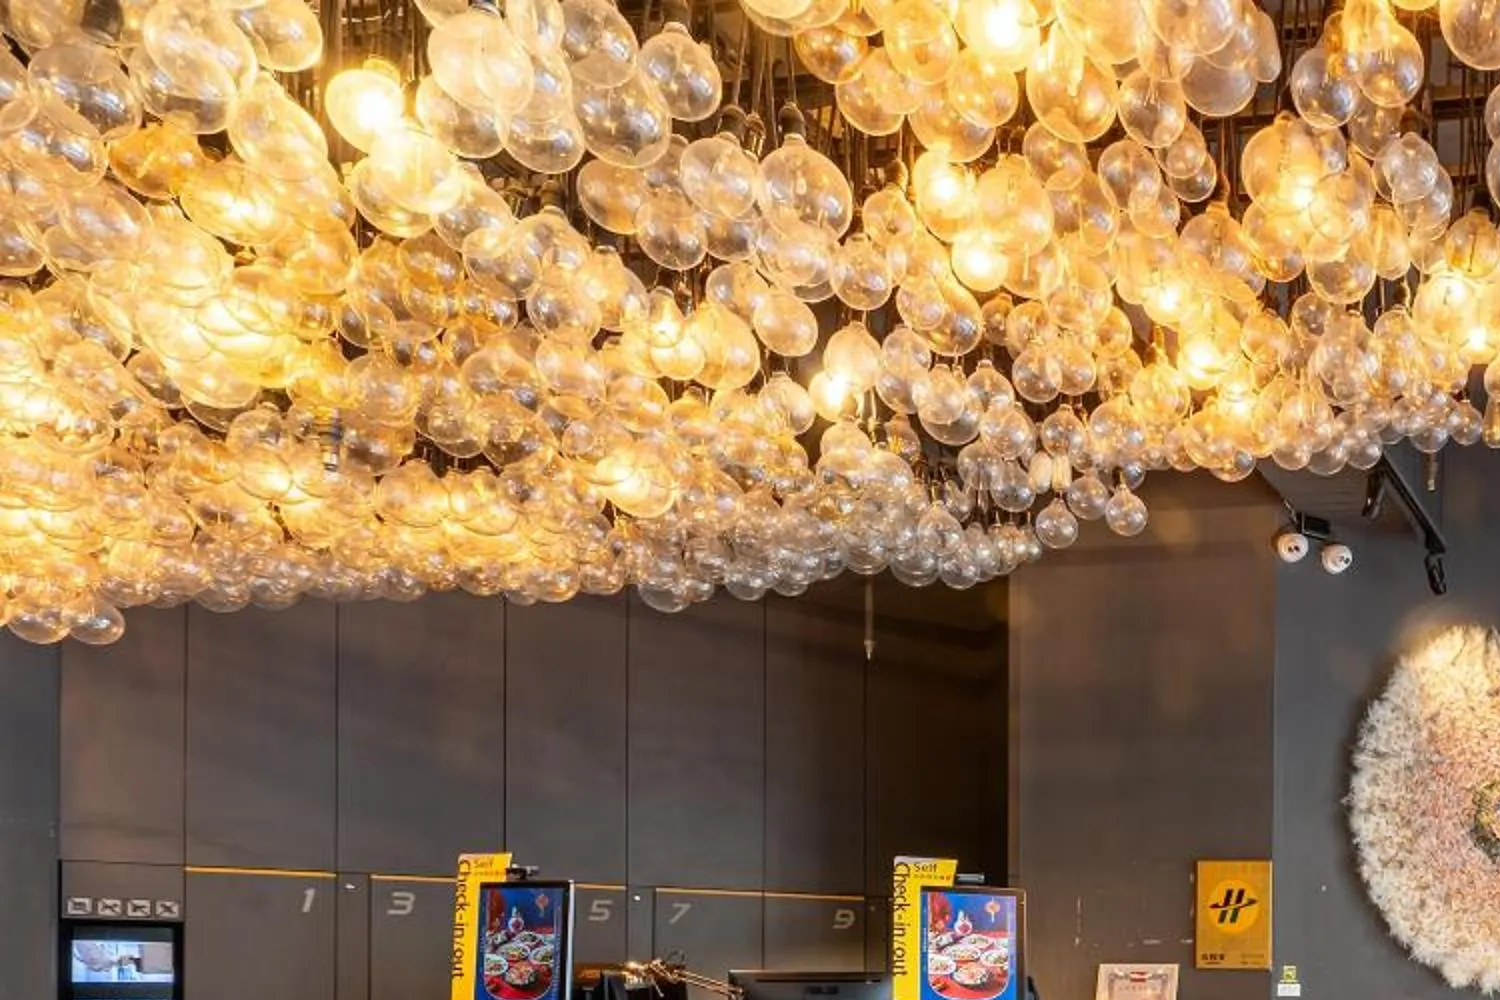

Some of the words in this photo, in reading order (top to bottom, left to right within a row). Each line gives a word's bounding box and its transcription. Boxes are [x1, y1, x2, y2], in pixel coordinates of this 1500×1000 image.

[914, 863, 937, 872] Self
[302, 889, 315, 912] 1
[386, 892, 415, 914] 3
[588, 900, 613, 921] 5
[669, 903, 691, 925] 7
[833, 909, 855, 929] 9
[894, 862, 910, 976] Check-in/out
